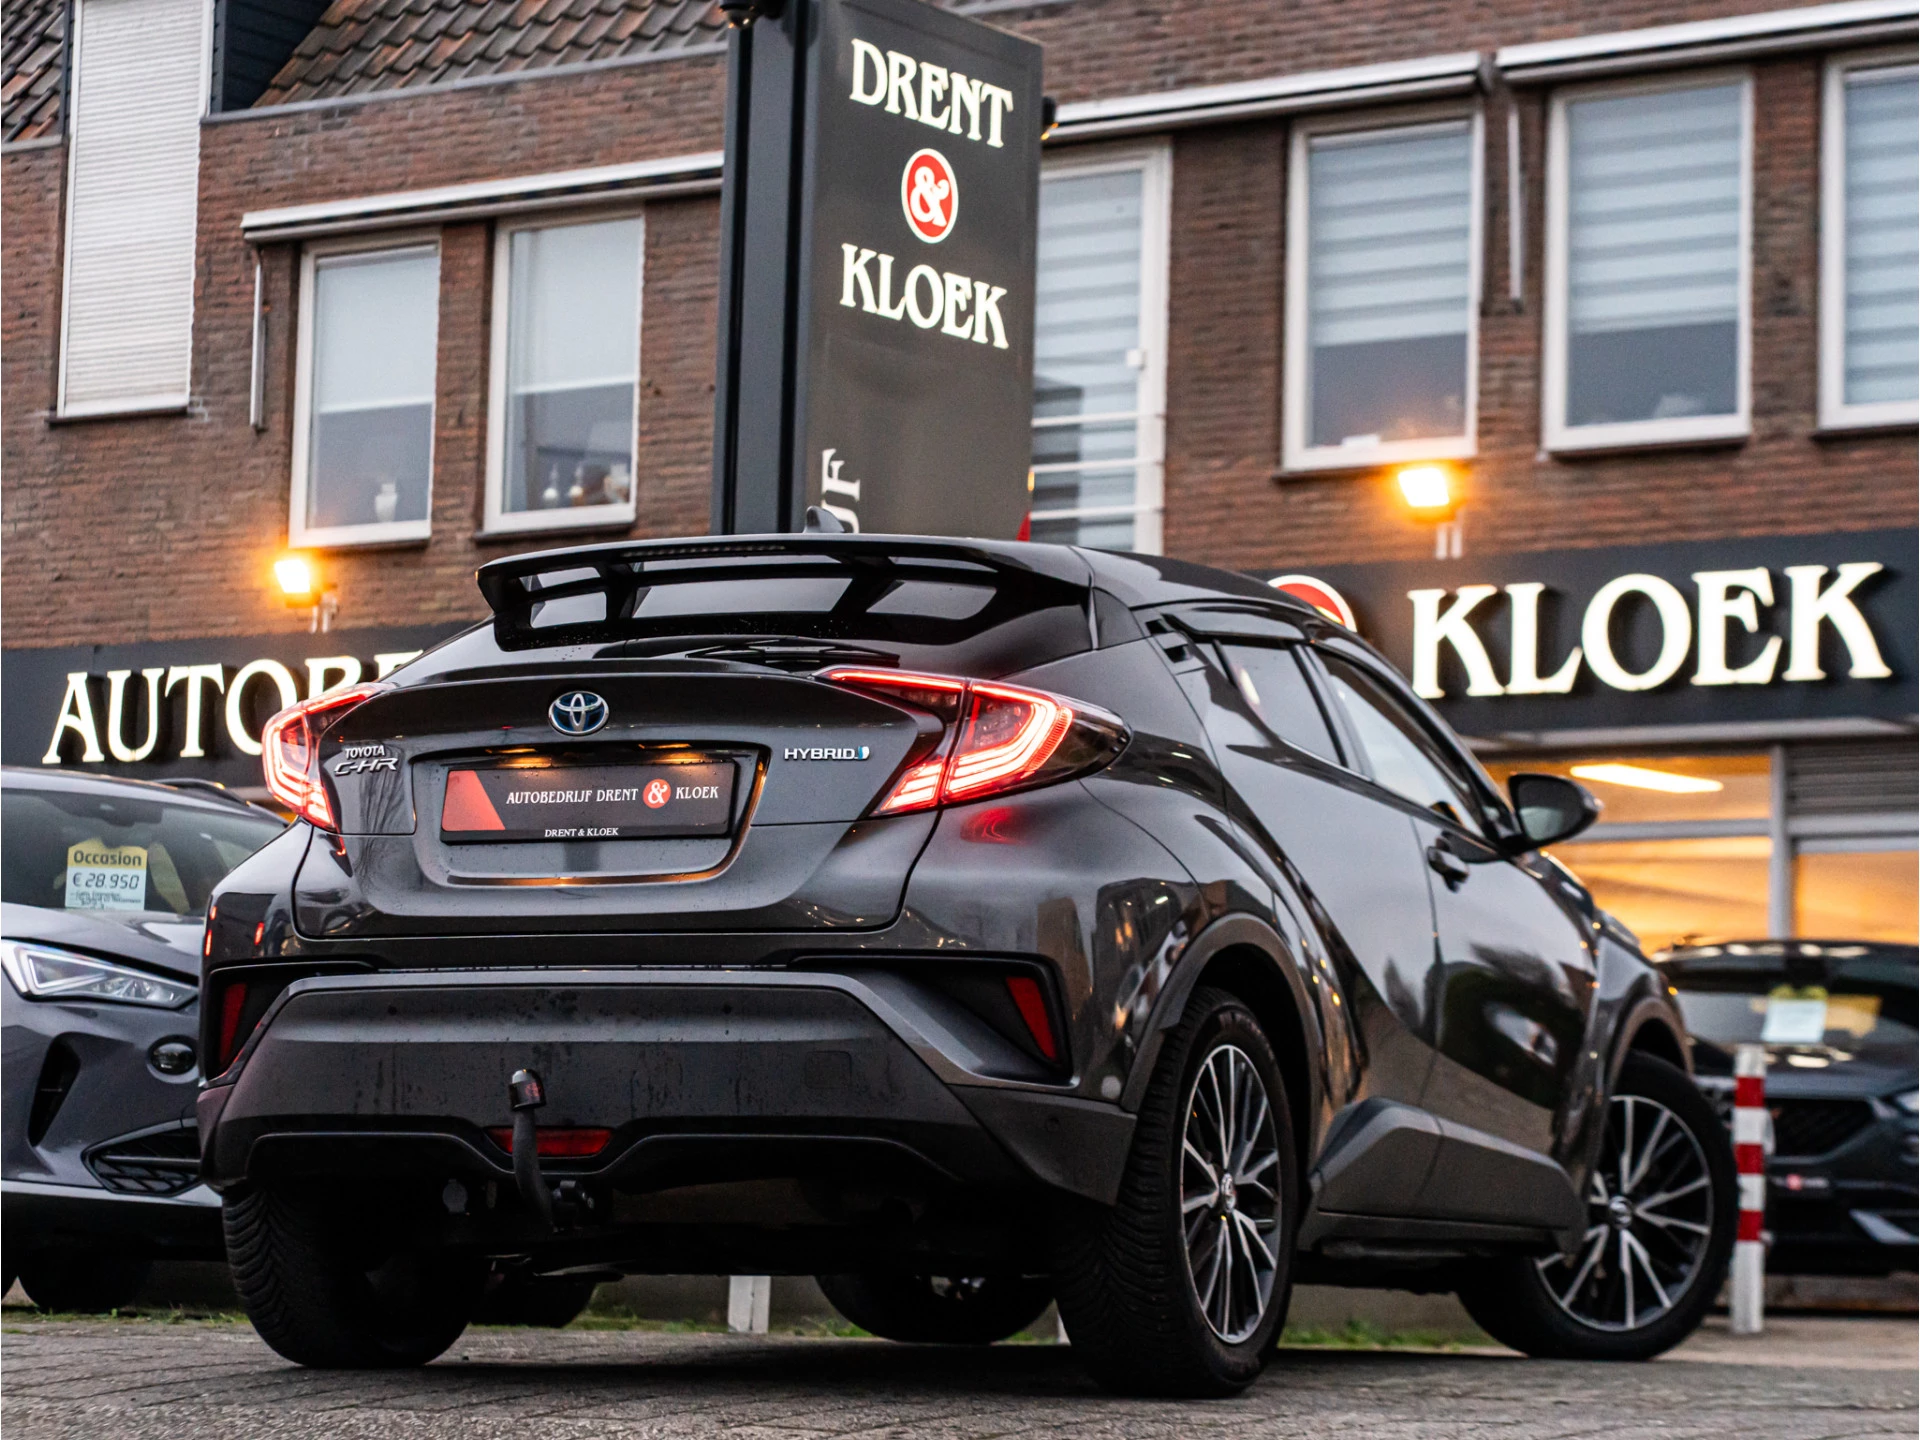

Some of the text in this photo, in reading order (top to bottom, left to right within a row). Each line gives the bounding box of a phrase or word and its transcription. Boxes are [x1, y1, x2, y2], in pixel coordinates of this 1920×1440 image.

[850, 38, 1013, 148] DRENT
[910, 166, 950, 227] &
[839, 243, 1009, 349] KLOEK
[1408, 562, 1892, 699] KLOEK
[42, 650, 424, 764] AUTO
[345, 745, 385, 759] TOYOTA
[784, 748, 856, 760] HYBRID
[334, 758, 398, 776] C-HR
[506, 781, 719, 805] AUTOBEDRIJF DRENT & KLOEK
[544, 827, 619, 838] DRENT & KLOEK
[73, 850, 142, 866] Occasion
